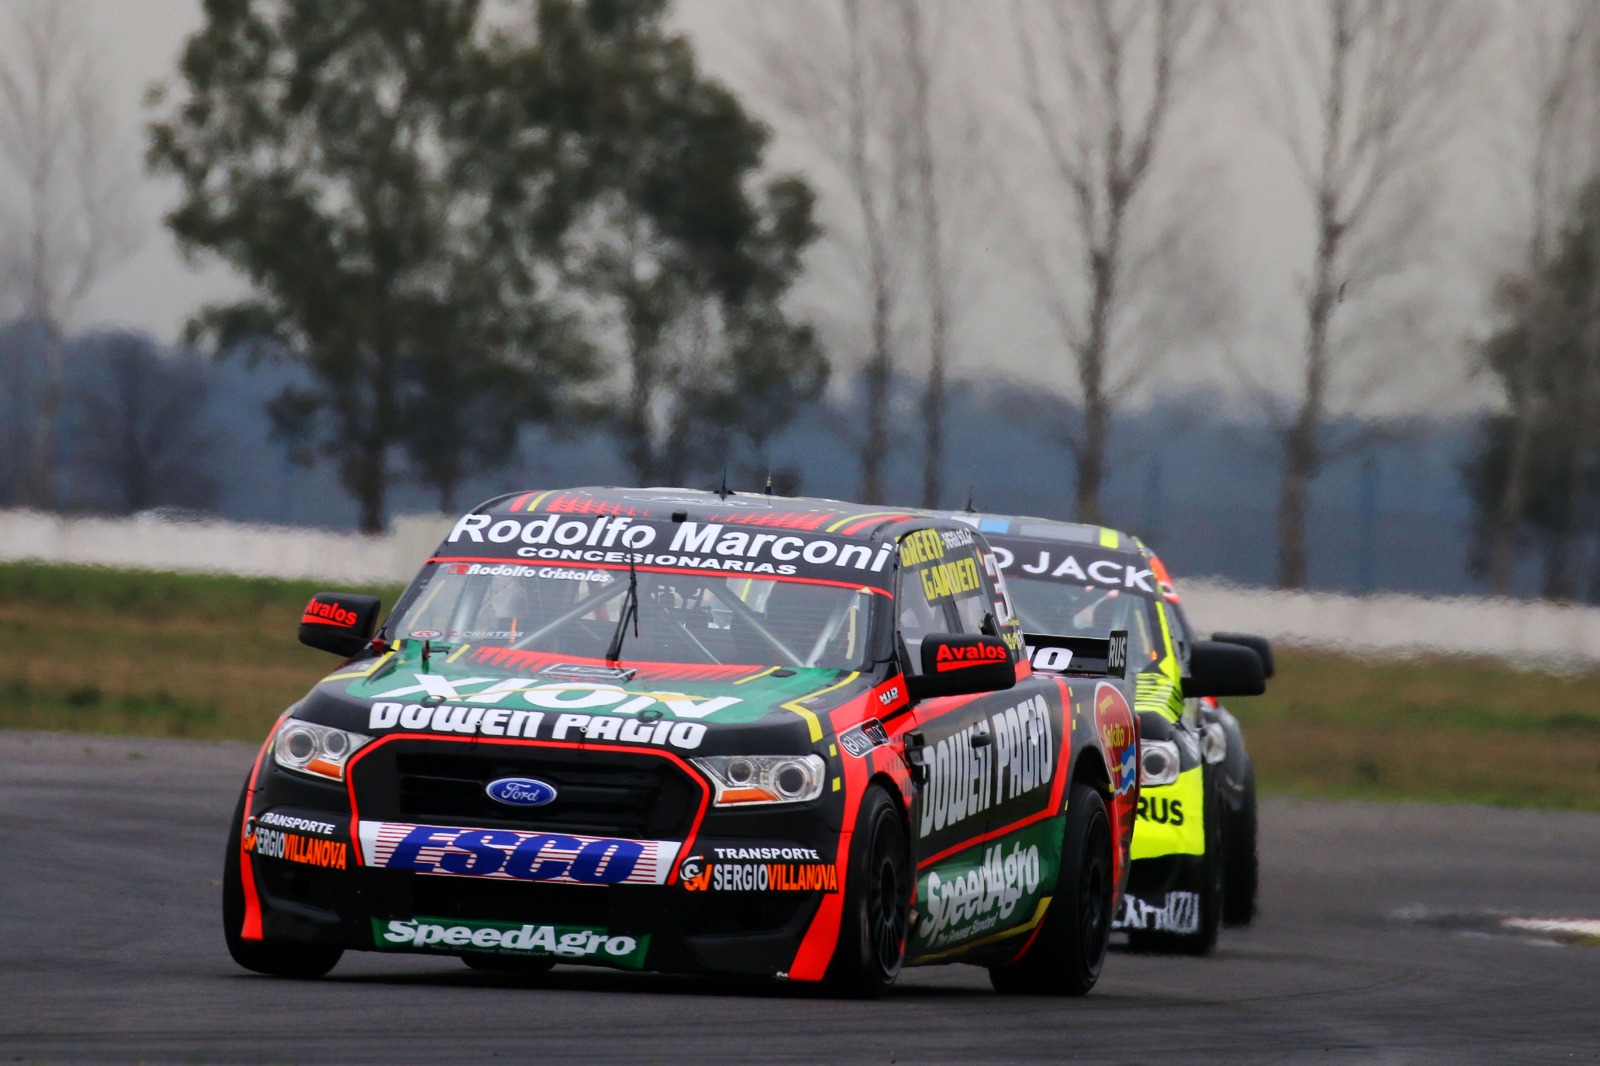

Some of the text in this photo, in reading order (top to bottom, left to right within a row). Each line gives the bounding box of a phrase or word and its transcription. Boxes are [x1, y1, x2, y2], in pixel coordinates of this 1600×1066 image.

[448, 514, 656, 549] Rodolfo
[669, 521, 893, 573] Marconi
[517, 547, 797, 575] CONCESIONARIAS
[467, 563, 611, 583] Rodolfo Cristales
[920, 557, 980, 600] GARDEN
[1022, 551, 1154, 593] JACK
[305, 598, 358, 626] Avalos
[936, 642, 1007, 661] Avalos
[1108, 636, 1126, 668] RUS
[371, 673, 744, 719] XION
[369, 702, 708, 749] DOWEN PAGIO
[920, 694, 1053, 838] DOWEN PAGIO
[500, 781, 540, 803] Ford
[260, 812, 335, 835] TRANSPORTE
[385, 826, 645, 884] ESCO
[714, 848, 820, 860] TRANSPORTE
[920, 841, 1040, 948] SpeedAgro
[383, 919, 637, 957] SpeedAgro
